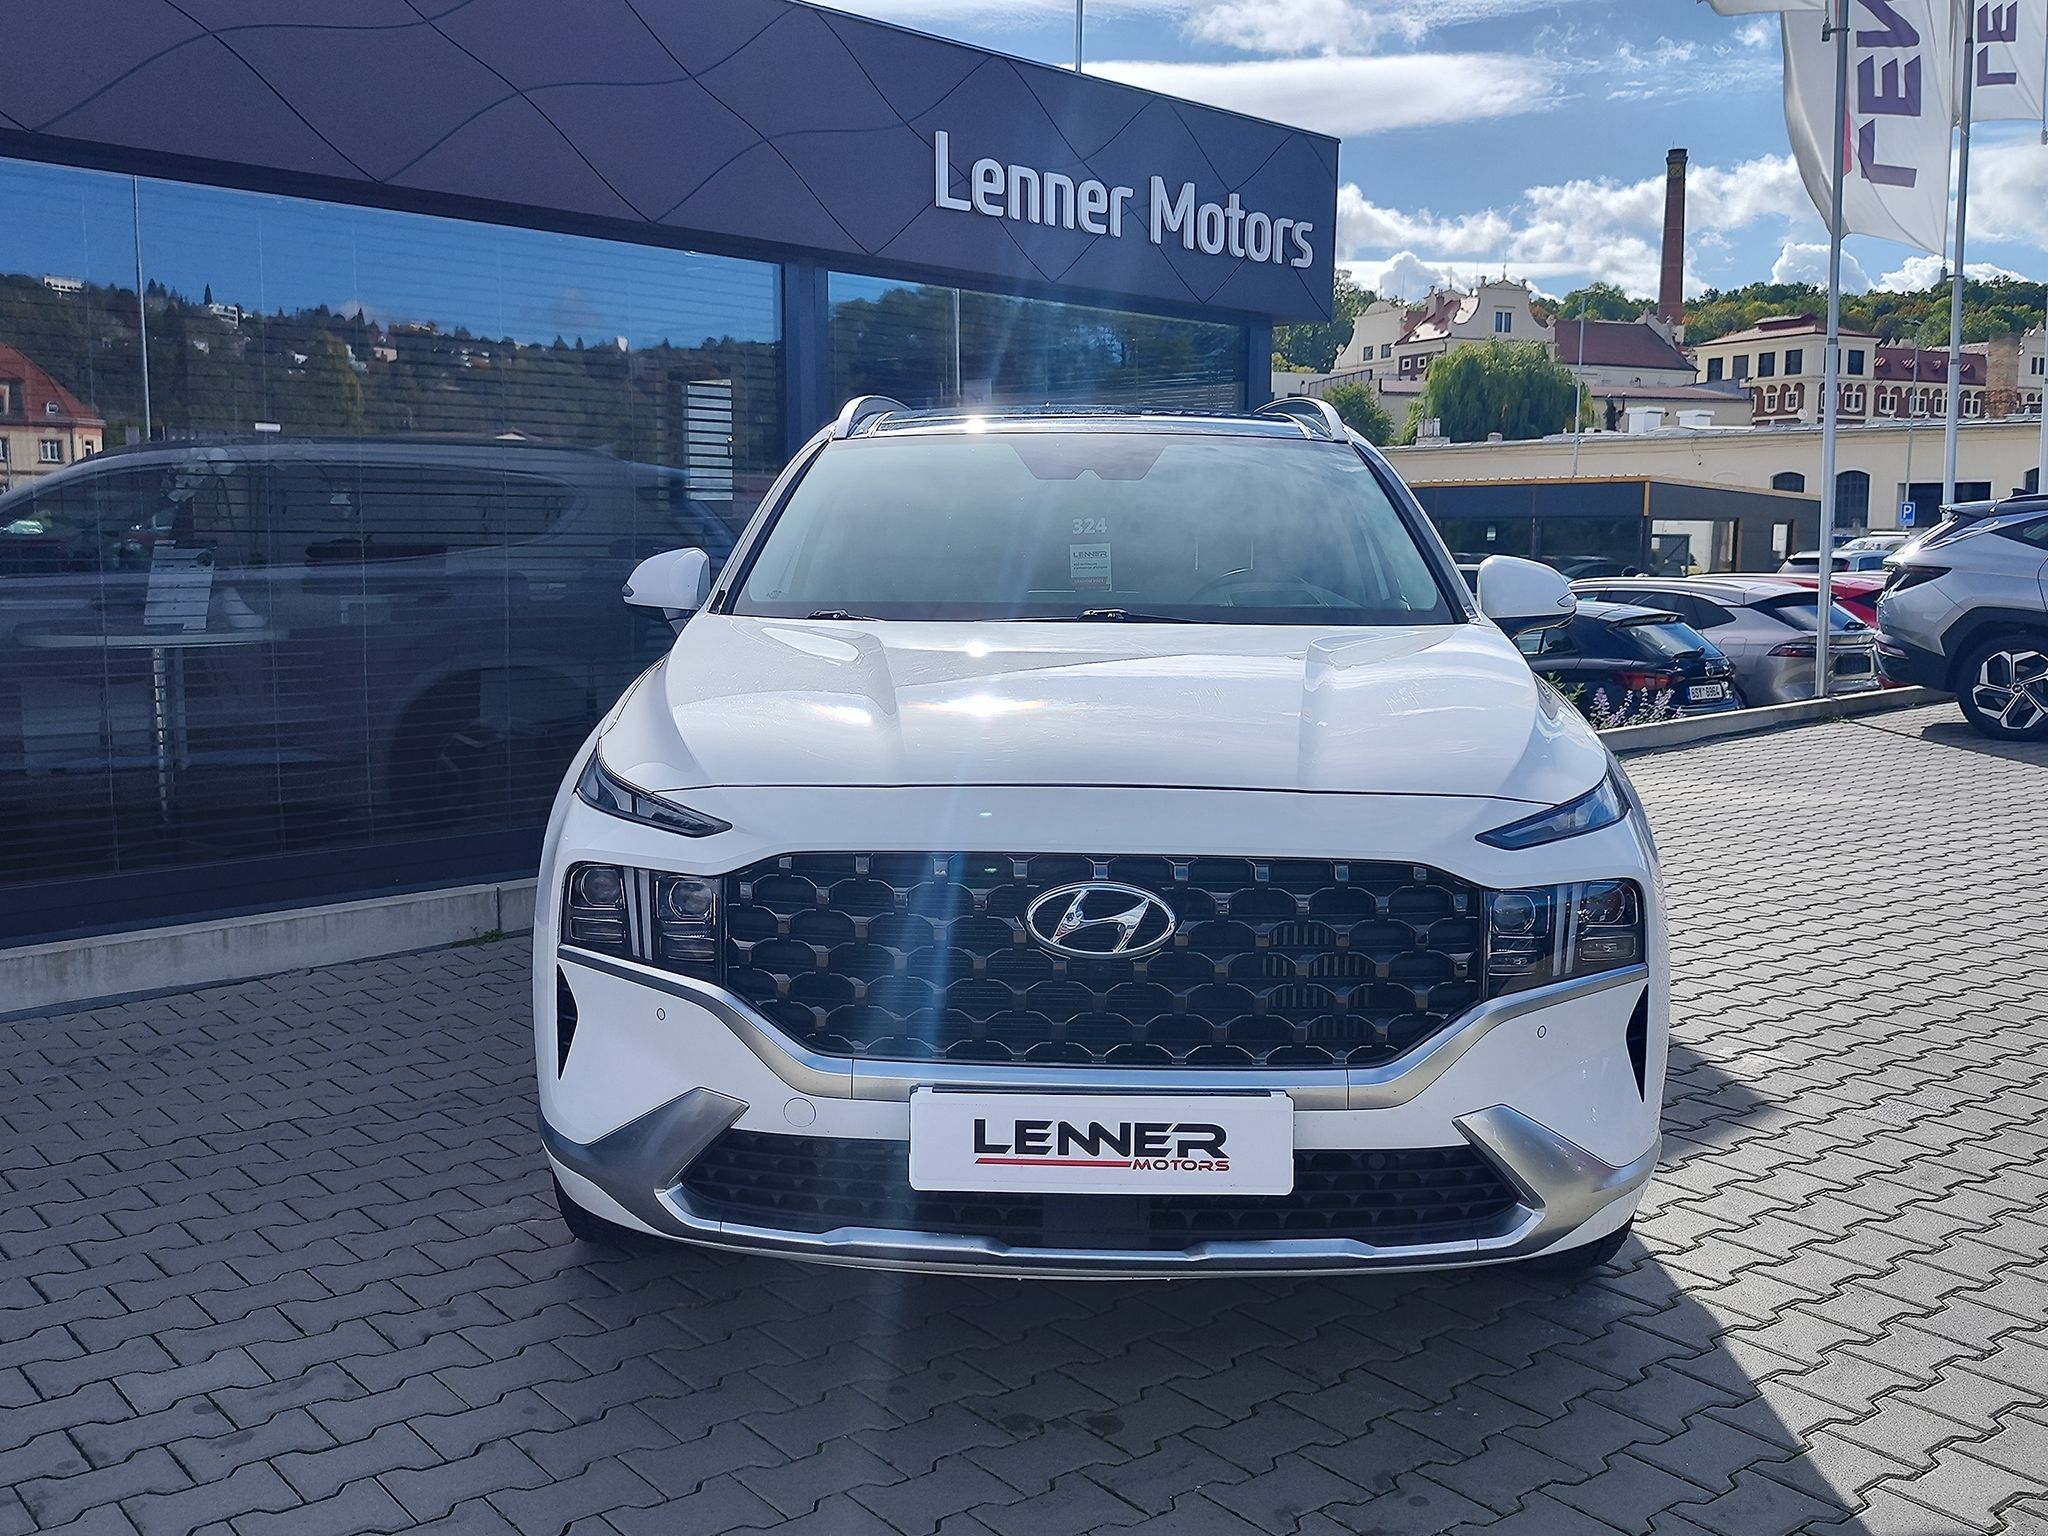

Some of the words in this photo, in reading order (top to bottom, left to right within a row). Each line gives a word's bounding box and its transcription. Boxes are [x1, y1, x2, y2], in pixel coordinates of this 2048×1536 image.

[935, 130, 1133, 238] Lenner
[1150, 175, 1313, 268] Motors
[1903, 505, 1912, 518] P
[1072, 517, 1107, 534] 324
[974, 1118, 1230, 1159] LENNER
[1132, 1159, 1230, 1171] MOTORS
